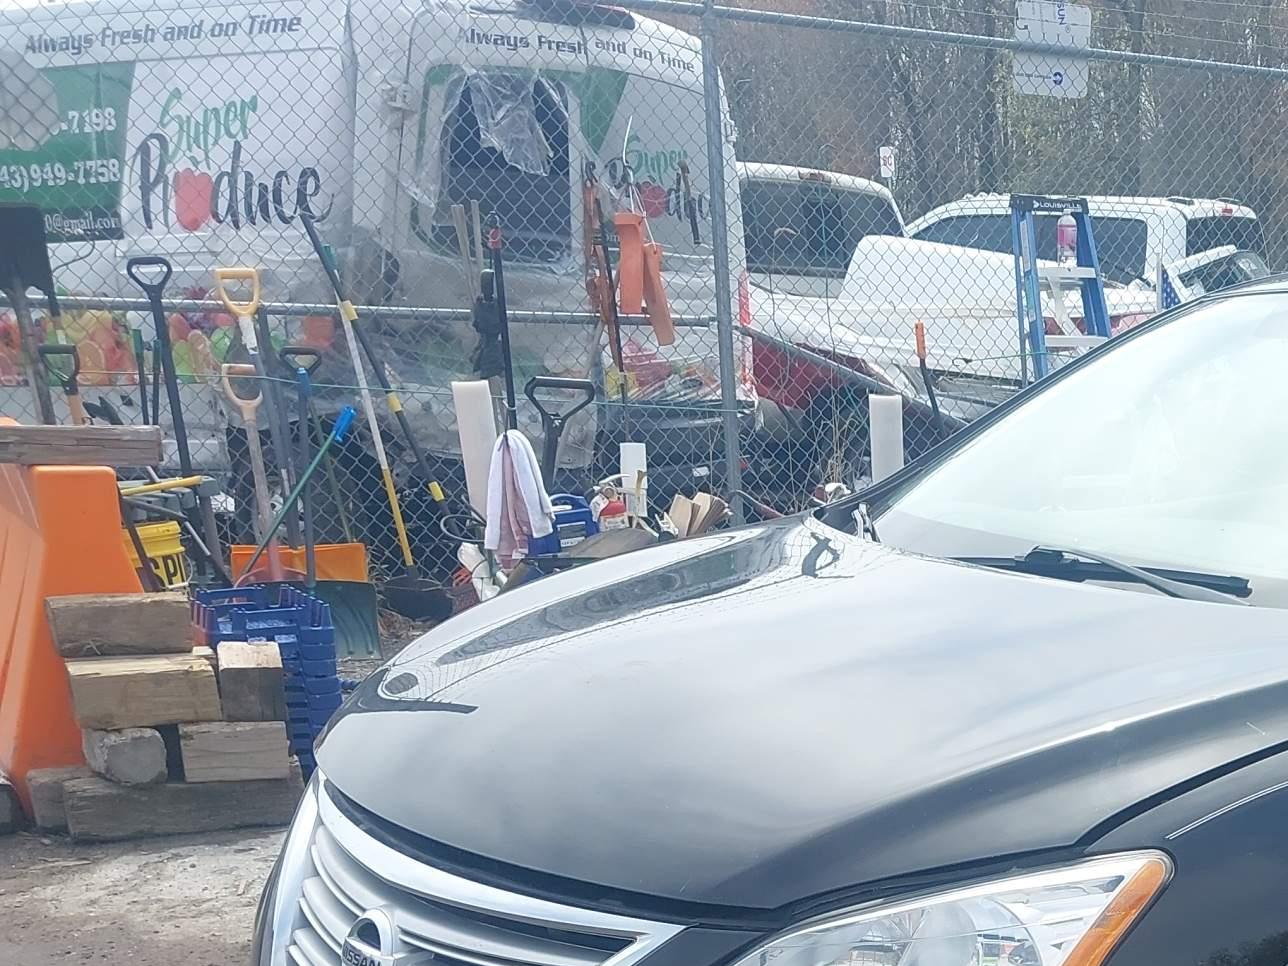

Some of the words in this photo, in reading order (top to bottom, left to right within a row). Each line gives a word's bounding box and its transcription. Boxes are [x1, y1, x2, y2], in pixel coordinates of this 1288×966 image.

[24, 33, 94, 56] Always
[101, 24, 155, 47] Fresh
[162, 20, 204, 42] and
[210, 20, 239, 38] on
[248, 14, 302, 36] Time
[537, 34, 588, 55] Fresh
[594, 39, 627, 54] and
[633, 48, 653, 60] on
[659, 52, 696, 73] Time
[159, 87, 258, 170] Super
[1040, 200, 1082, 209] LOUISVILLE
